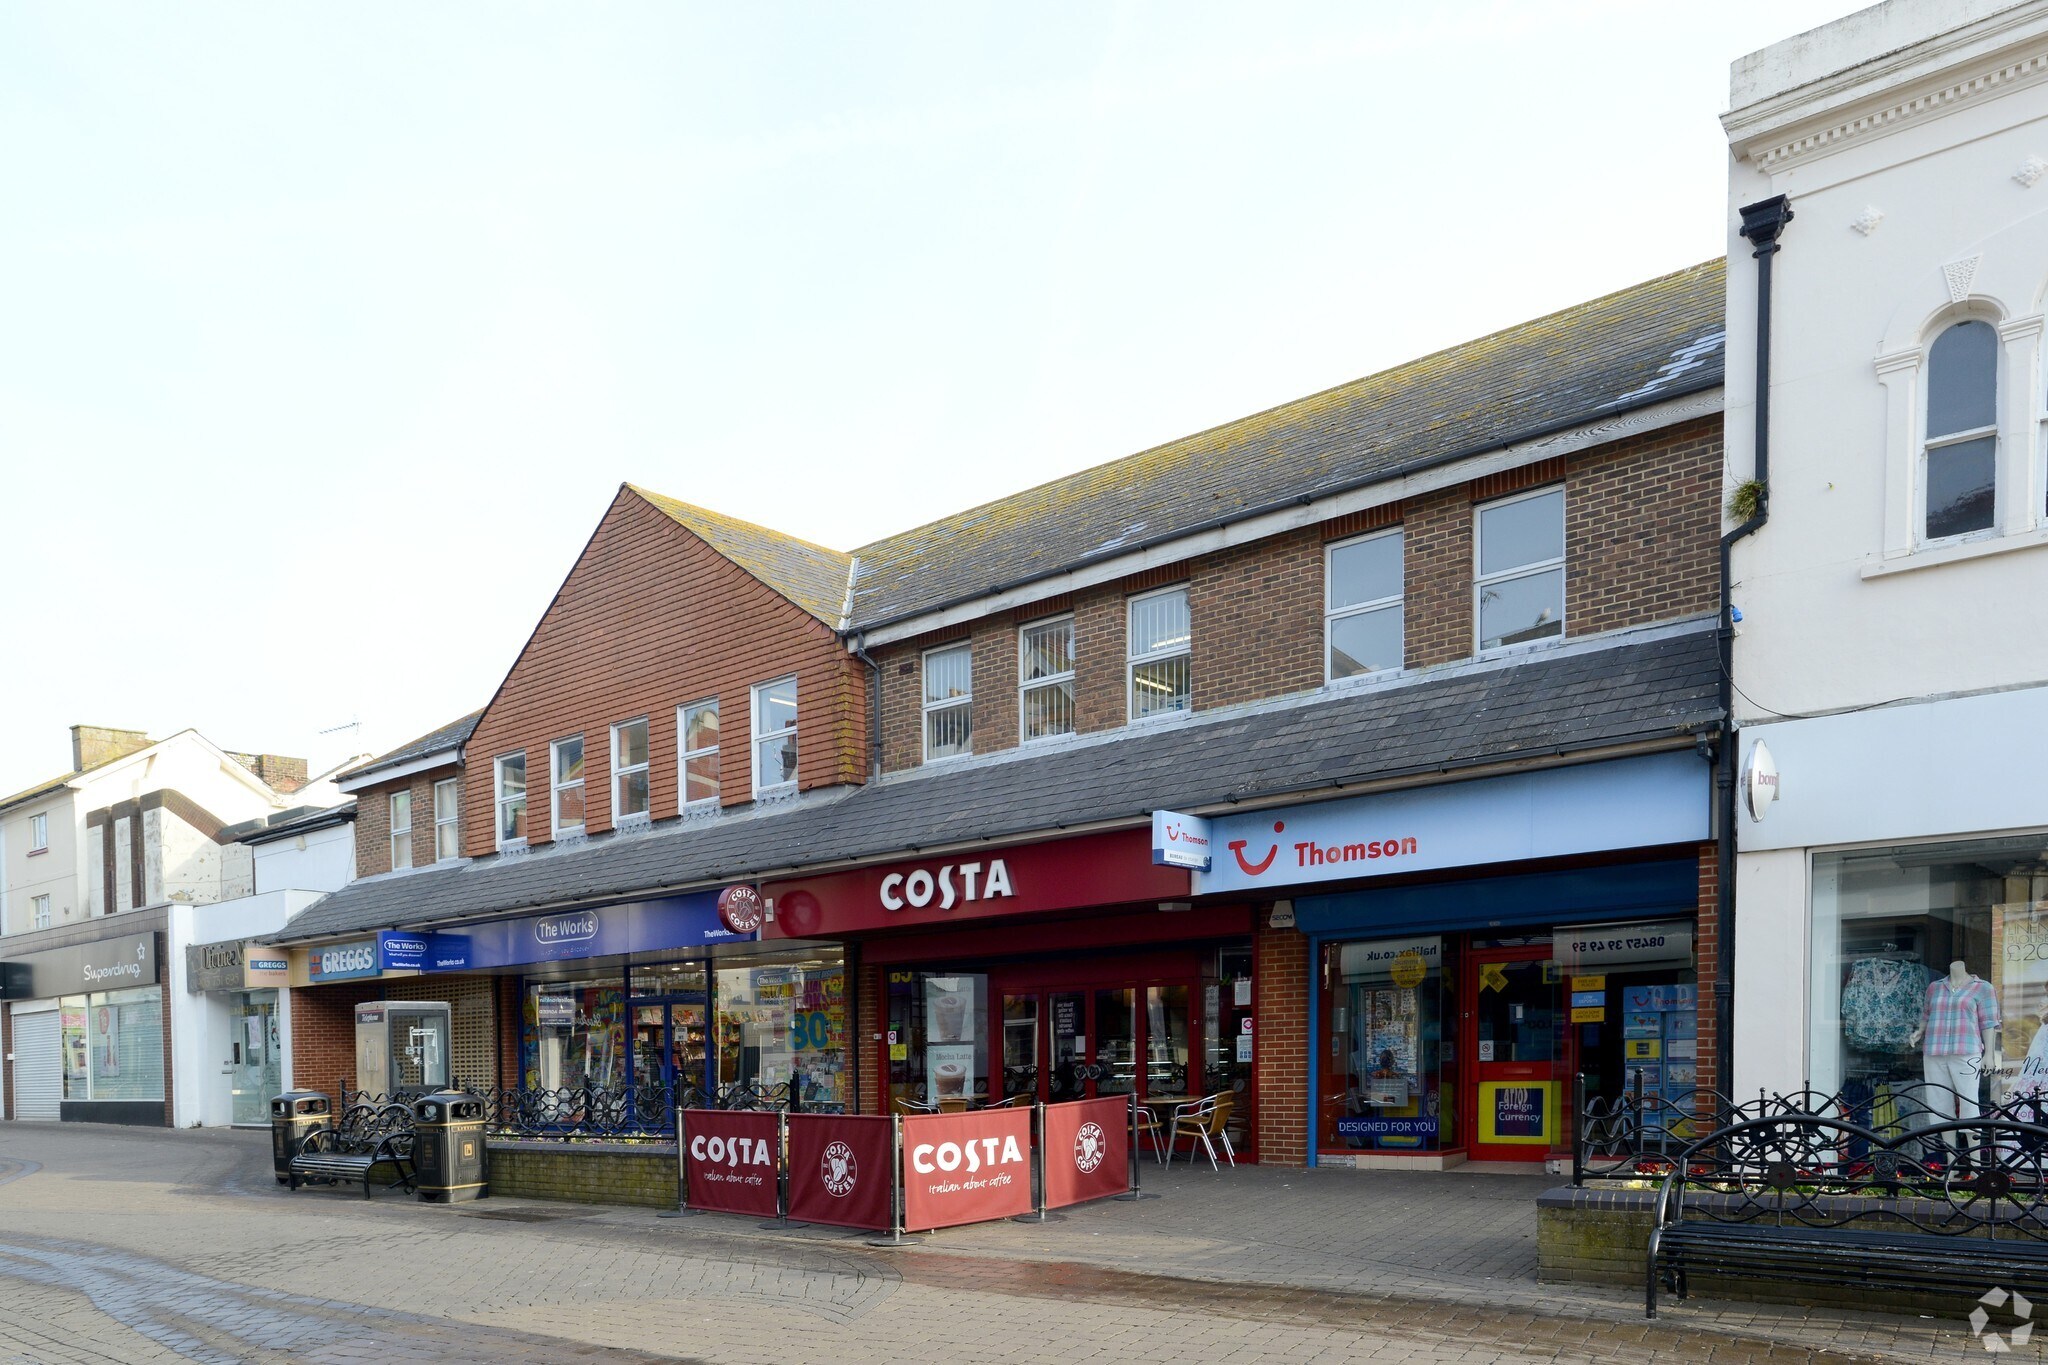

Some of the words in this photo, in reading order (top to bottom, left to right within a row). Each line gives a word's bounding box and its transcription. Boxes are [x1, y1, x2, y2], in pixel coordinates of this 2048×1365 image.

[1182, 832, 1208, 846] Thomson
[1294, 836, 1417, 868] Thomson
[880, 859, 1015, 910] COSTA
[732, 889, 756, 902] COSTA
[539, 922, 558, 938] The
[560, 918, 594, 936] Works
[730, 913, 760, 929] COFFEE
[387, 942, 401, 950] The
[401, 943, 424, 951] Works
[258, 961, 287, 969] GREGGS
[322, 947, 374, 974] GREGGS
[84, 961, 142, 983] Superdrug
[936, 1053, 955, 1061] Mocha
[956, 1053, 972, 1061] Latte
[1960, 1057, 2014, 1080] Spring
[1498, 1101, 1533, 1112] Foreign
[1498, 1112, 1541, 1123] Currency
[1079, 1125, 1100, 1141] COSTA
[1339, 1121, 1388, 1132] DESIGNED
[1391, 1121, 1412, 1132] FOR
[1414, 1121, 1436, 1132] YOU
[691, 1135, 771, 1168] COSTA
[826, 1144, 850, 1160] COSTA
[913, 1135, 1024, 1173] COSTA
[1078, 1151, 1102, 1170] COFFEE
[726, 1170, 743, 1184] about
[744, 1172, 763, 1186] coffee
[824, 1174, 854, 1193] COFFEE
[929, 1179, 961, 1194] Italian
[963, 1175, 988, 1190] about
[989, 1172, 1012, 1187] coffee
